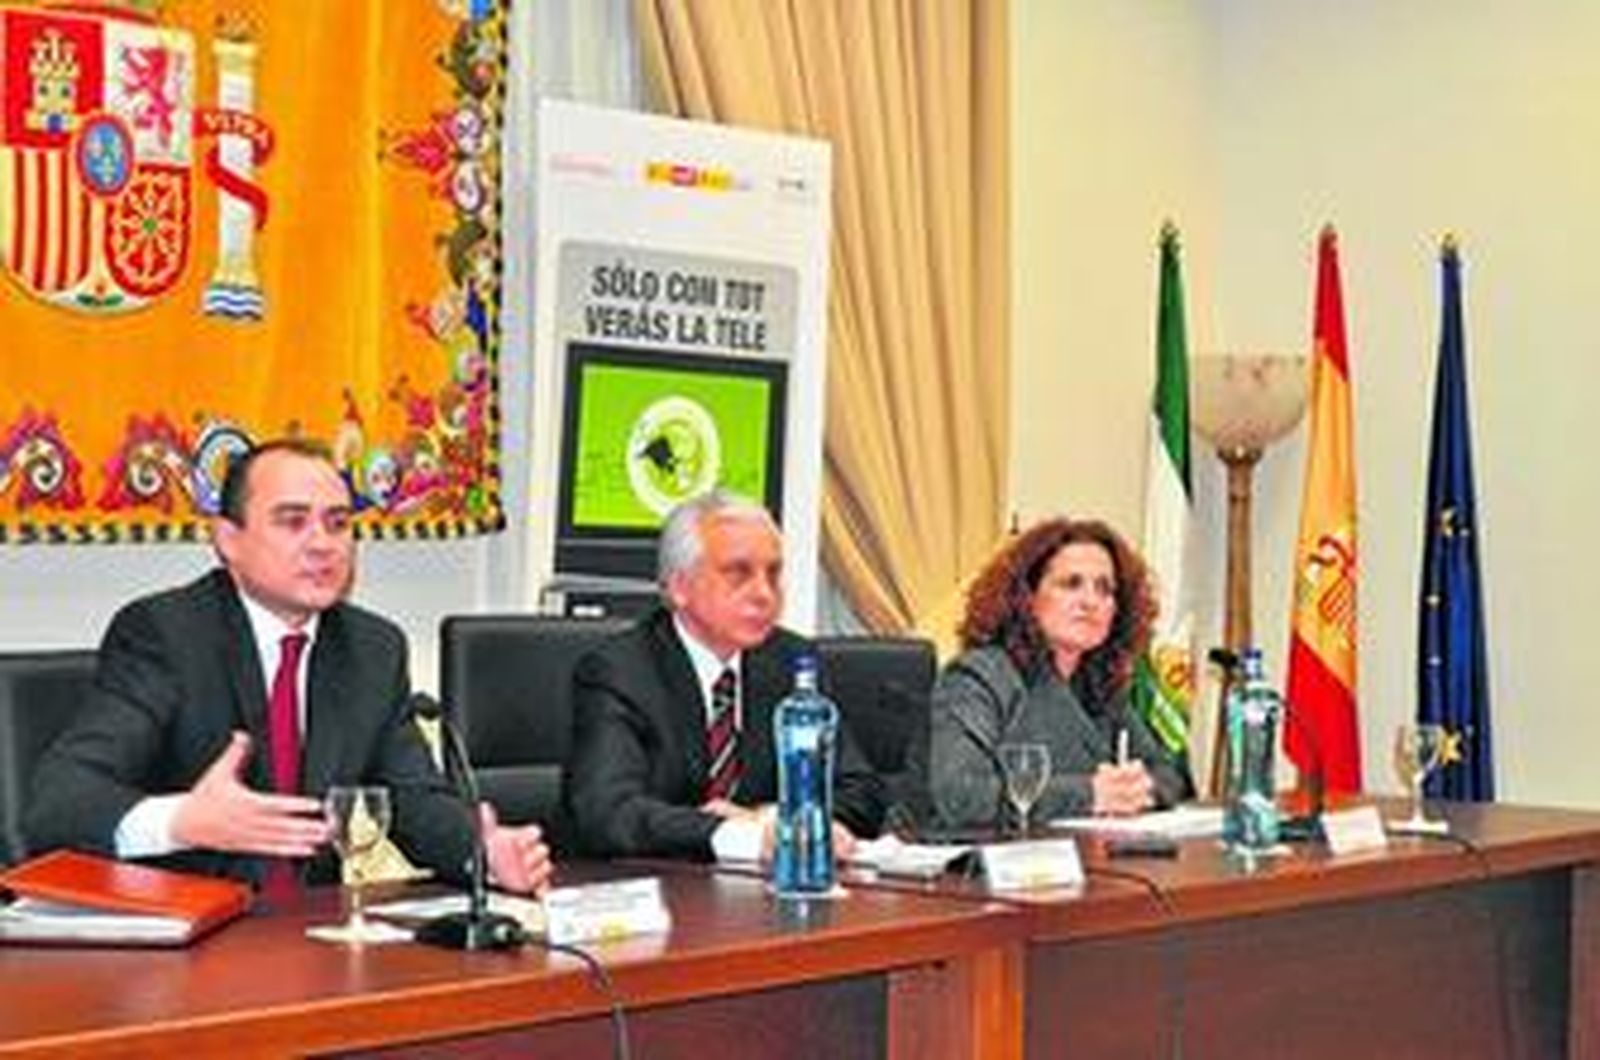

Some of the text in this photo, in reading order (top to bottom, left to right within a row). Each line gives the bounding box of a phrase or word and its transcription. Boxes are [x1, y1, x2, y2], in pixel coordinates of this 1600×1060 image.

[591, 260, 766, 312] SÓLO CON TDT
[585, 306, 767, 350] VERÁS LA TELE
